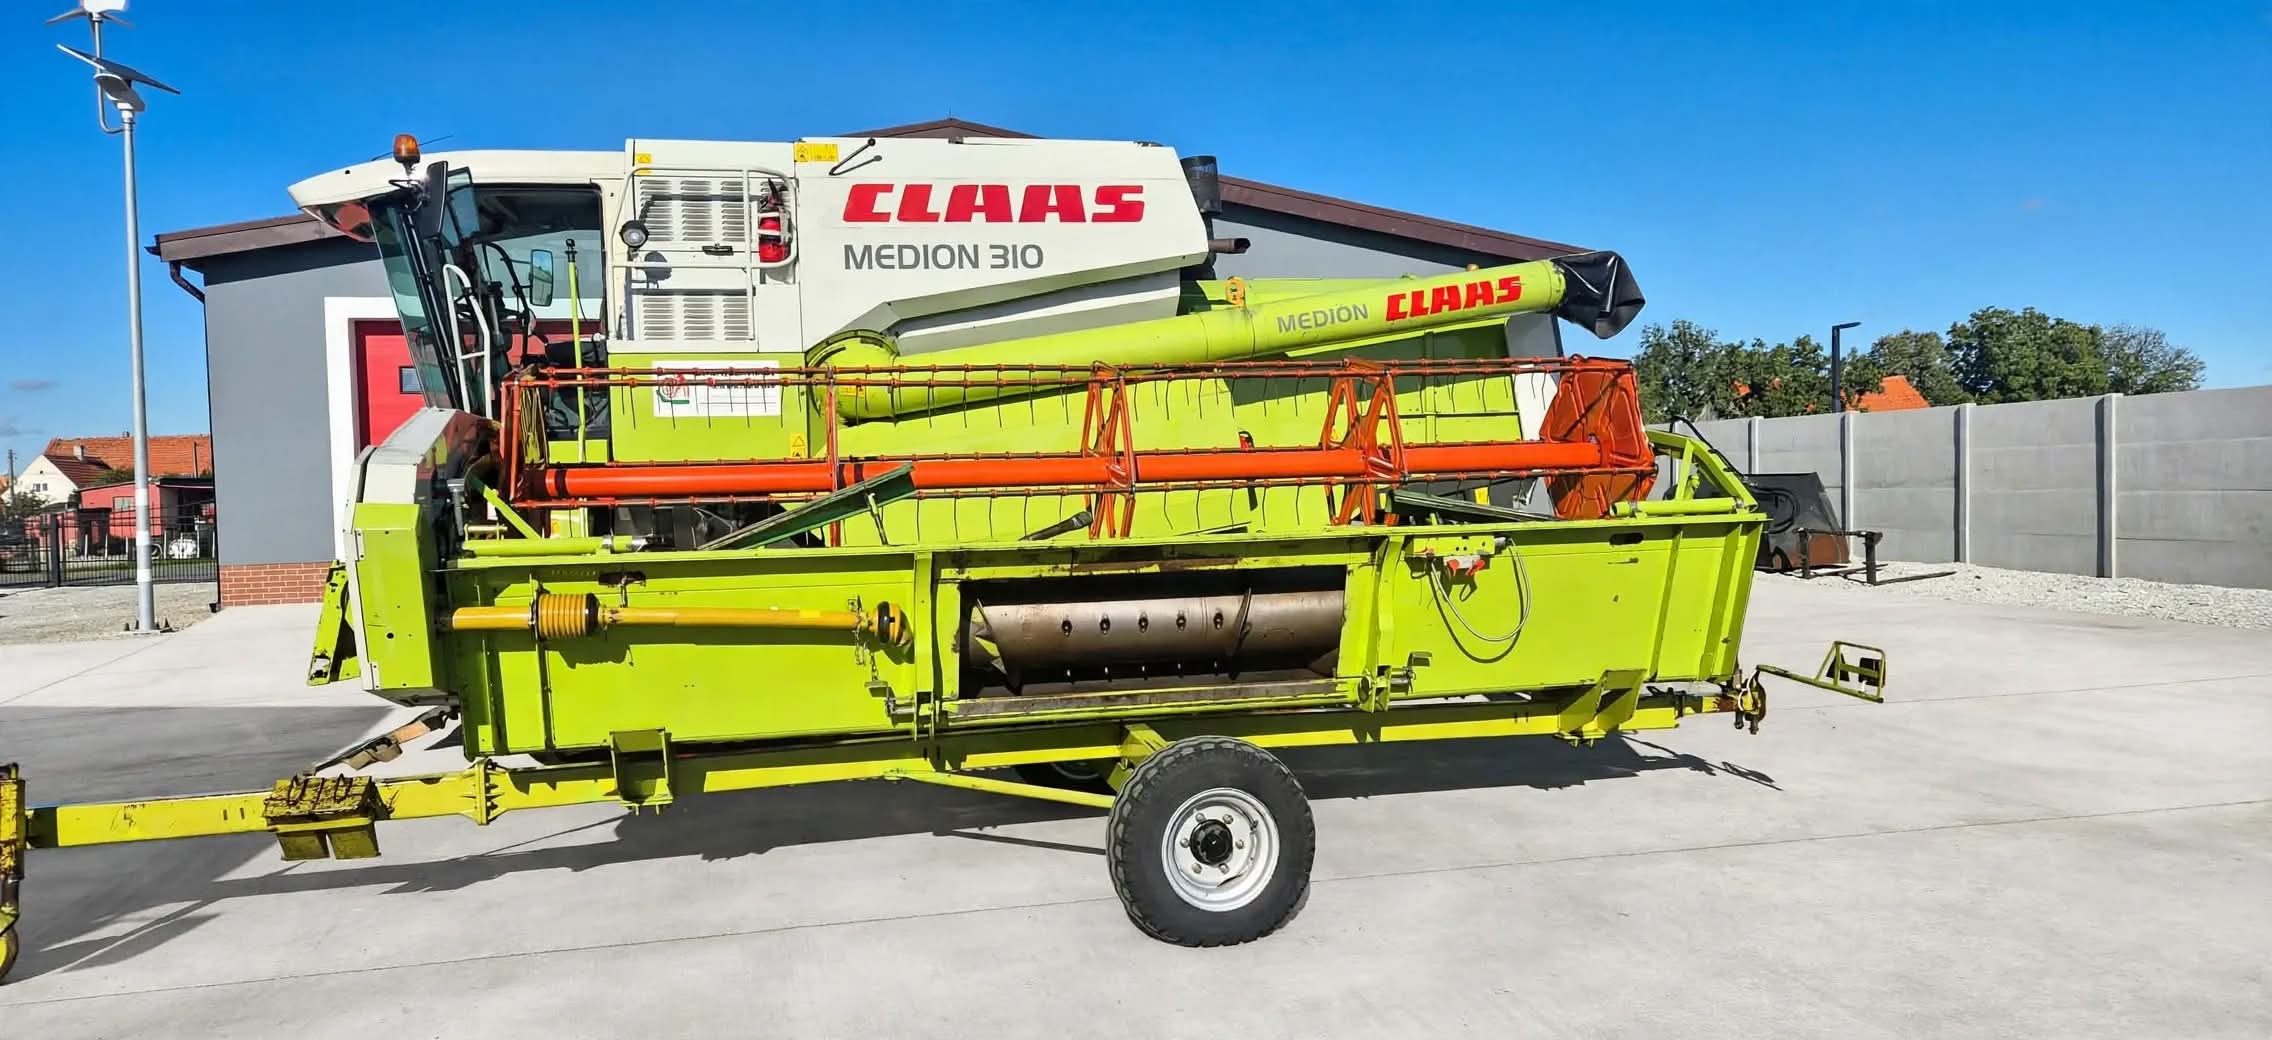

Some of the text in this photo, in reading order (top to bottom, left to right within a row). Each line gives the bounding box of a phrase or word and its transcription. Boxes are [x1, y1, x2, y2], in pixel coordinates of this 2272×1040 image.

[843, 183, 1145, 223] CLAAS
[843, 244, 1044, 270] MEDION 310
[1277, 276, 1522, 333] MEDION CLAAS
